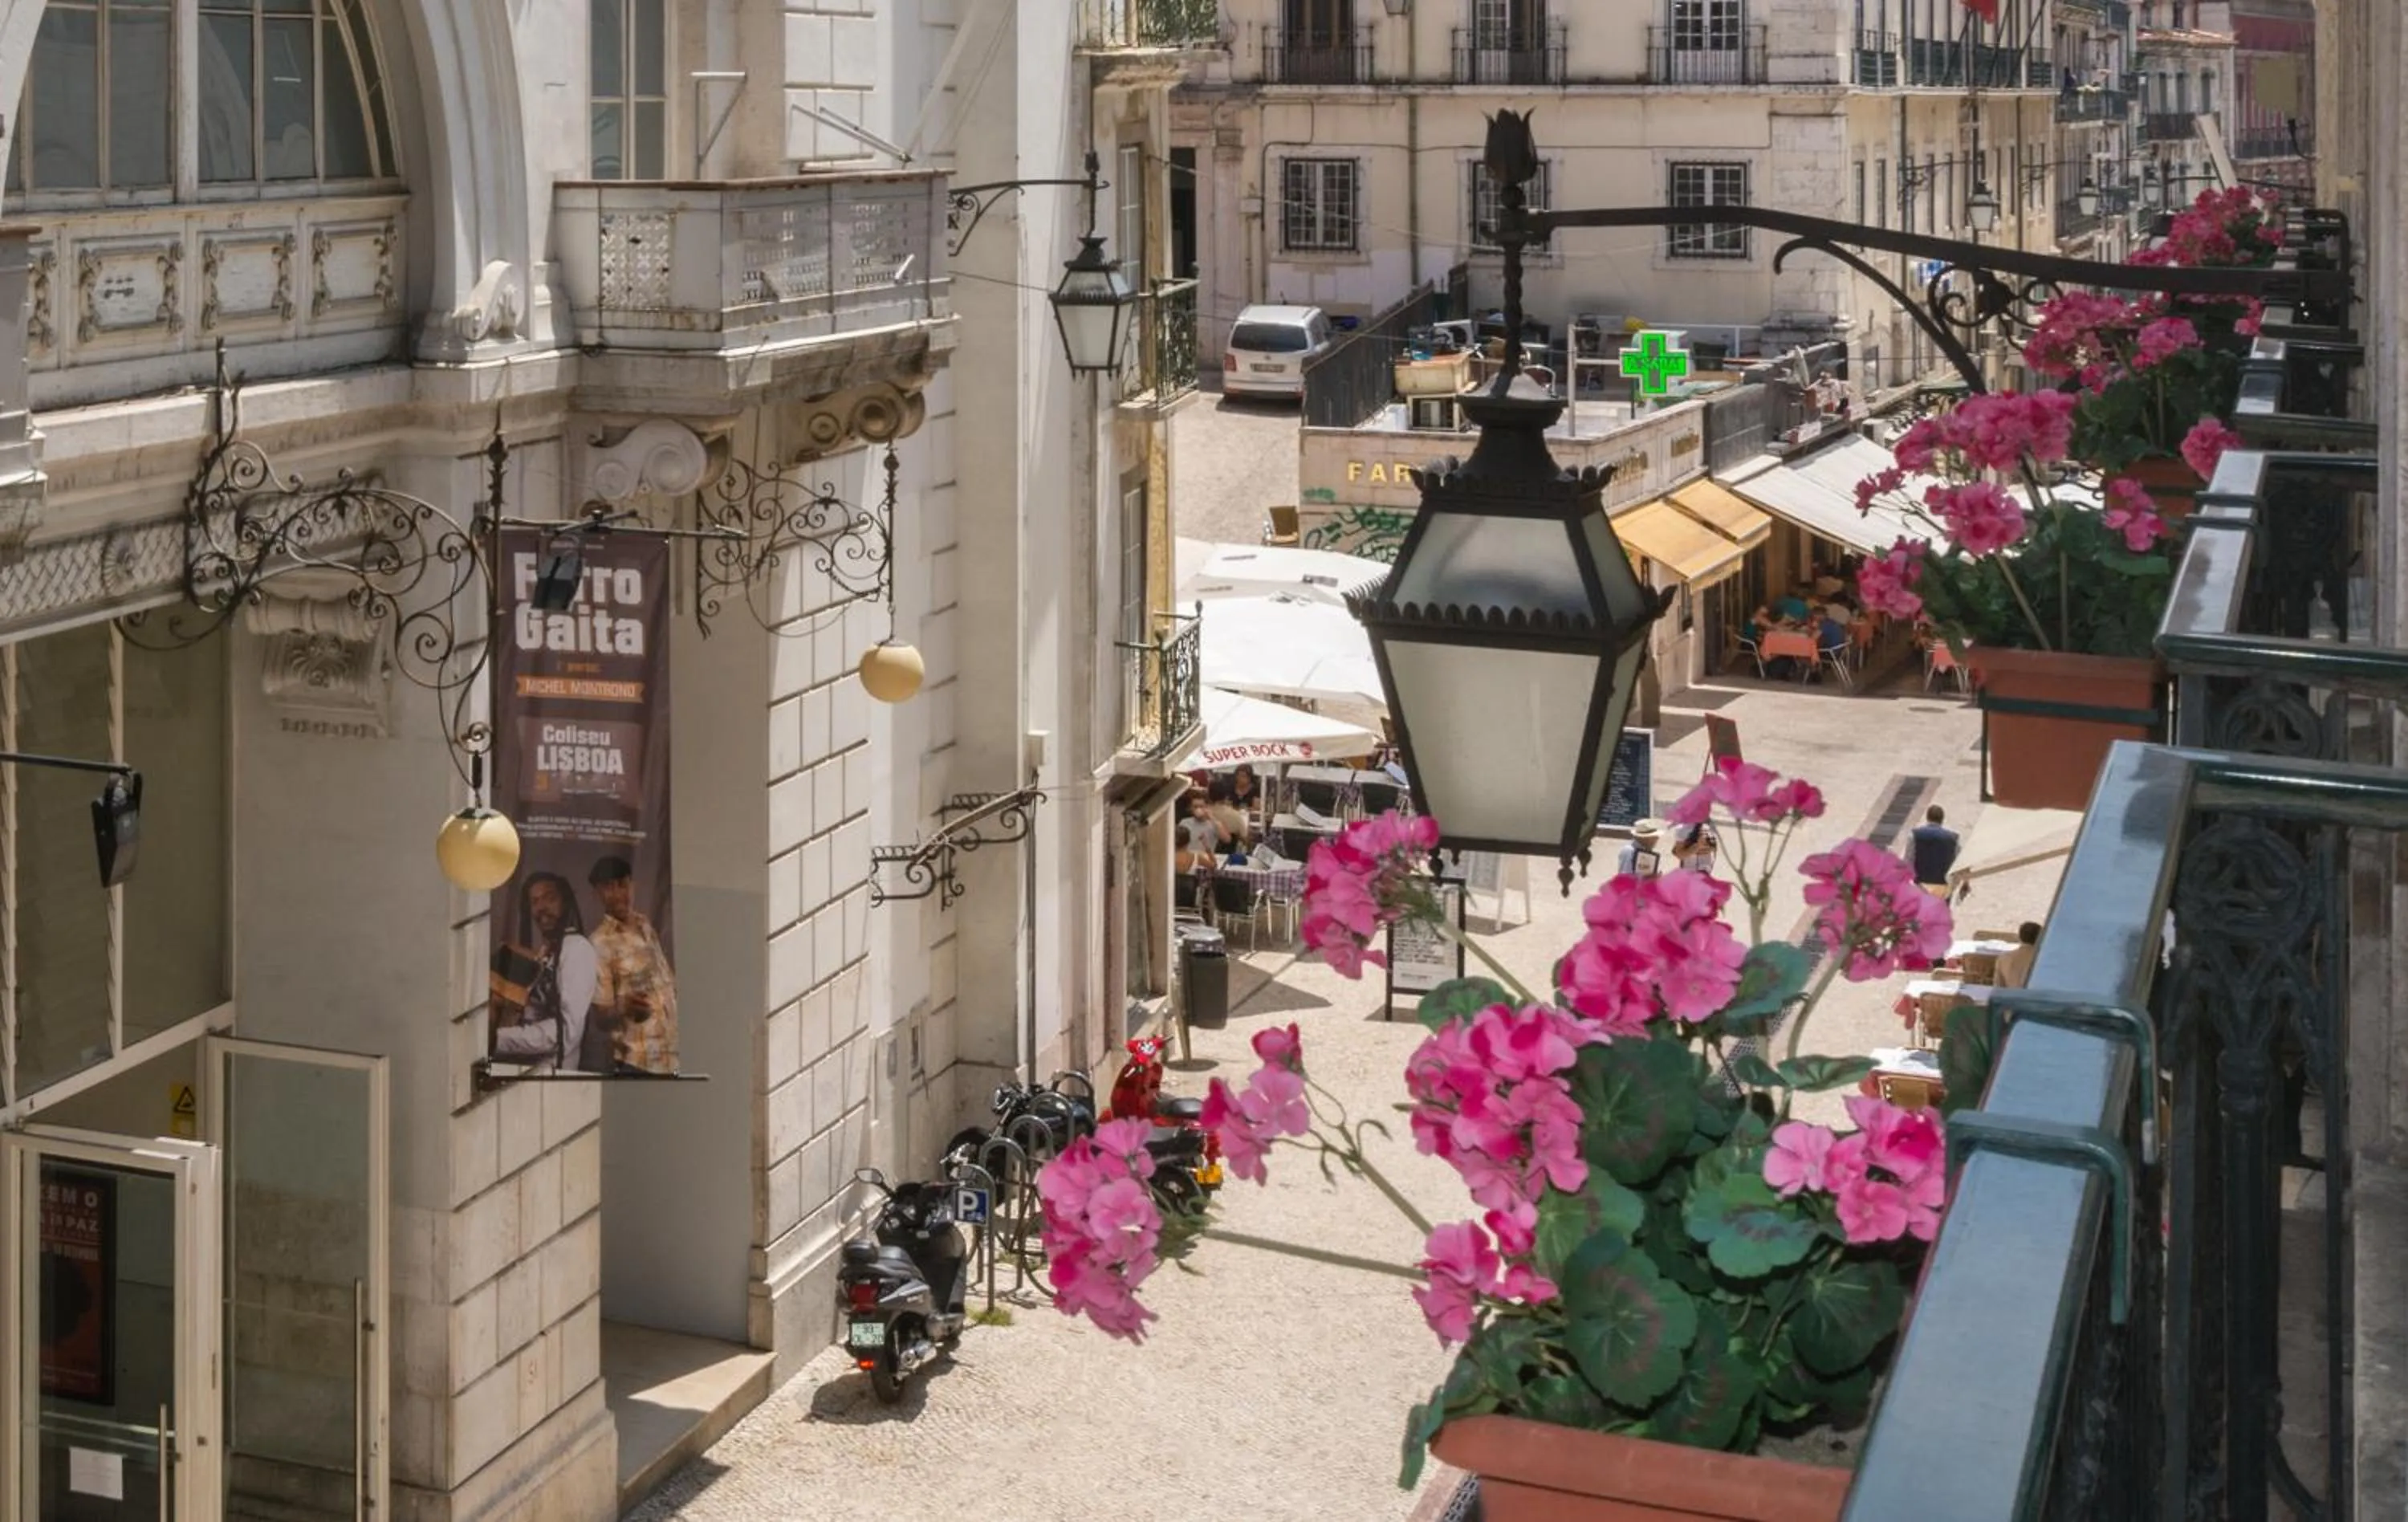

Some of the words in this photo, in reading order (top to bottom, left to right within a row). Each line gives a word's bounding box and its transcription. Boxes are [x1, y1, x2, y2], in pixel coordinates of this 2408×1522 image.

[514, 551, 641, 604] Frro
[515, 603, 643, 655] Gaita
[543, 724, 611, 746] Coliseu
[537, 744, 624, 775] LISBOA
[1203, 746, 1248, 763] SUPER
[1250, 742, 1291, 756] BOCK
[958, 1190, 979, 1219] P
